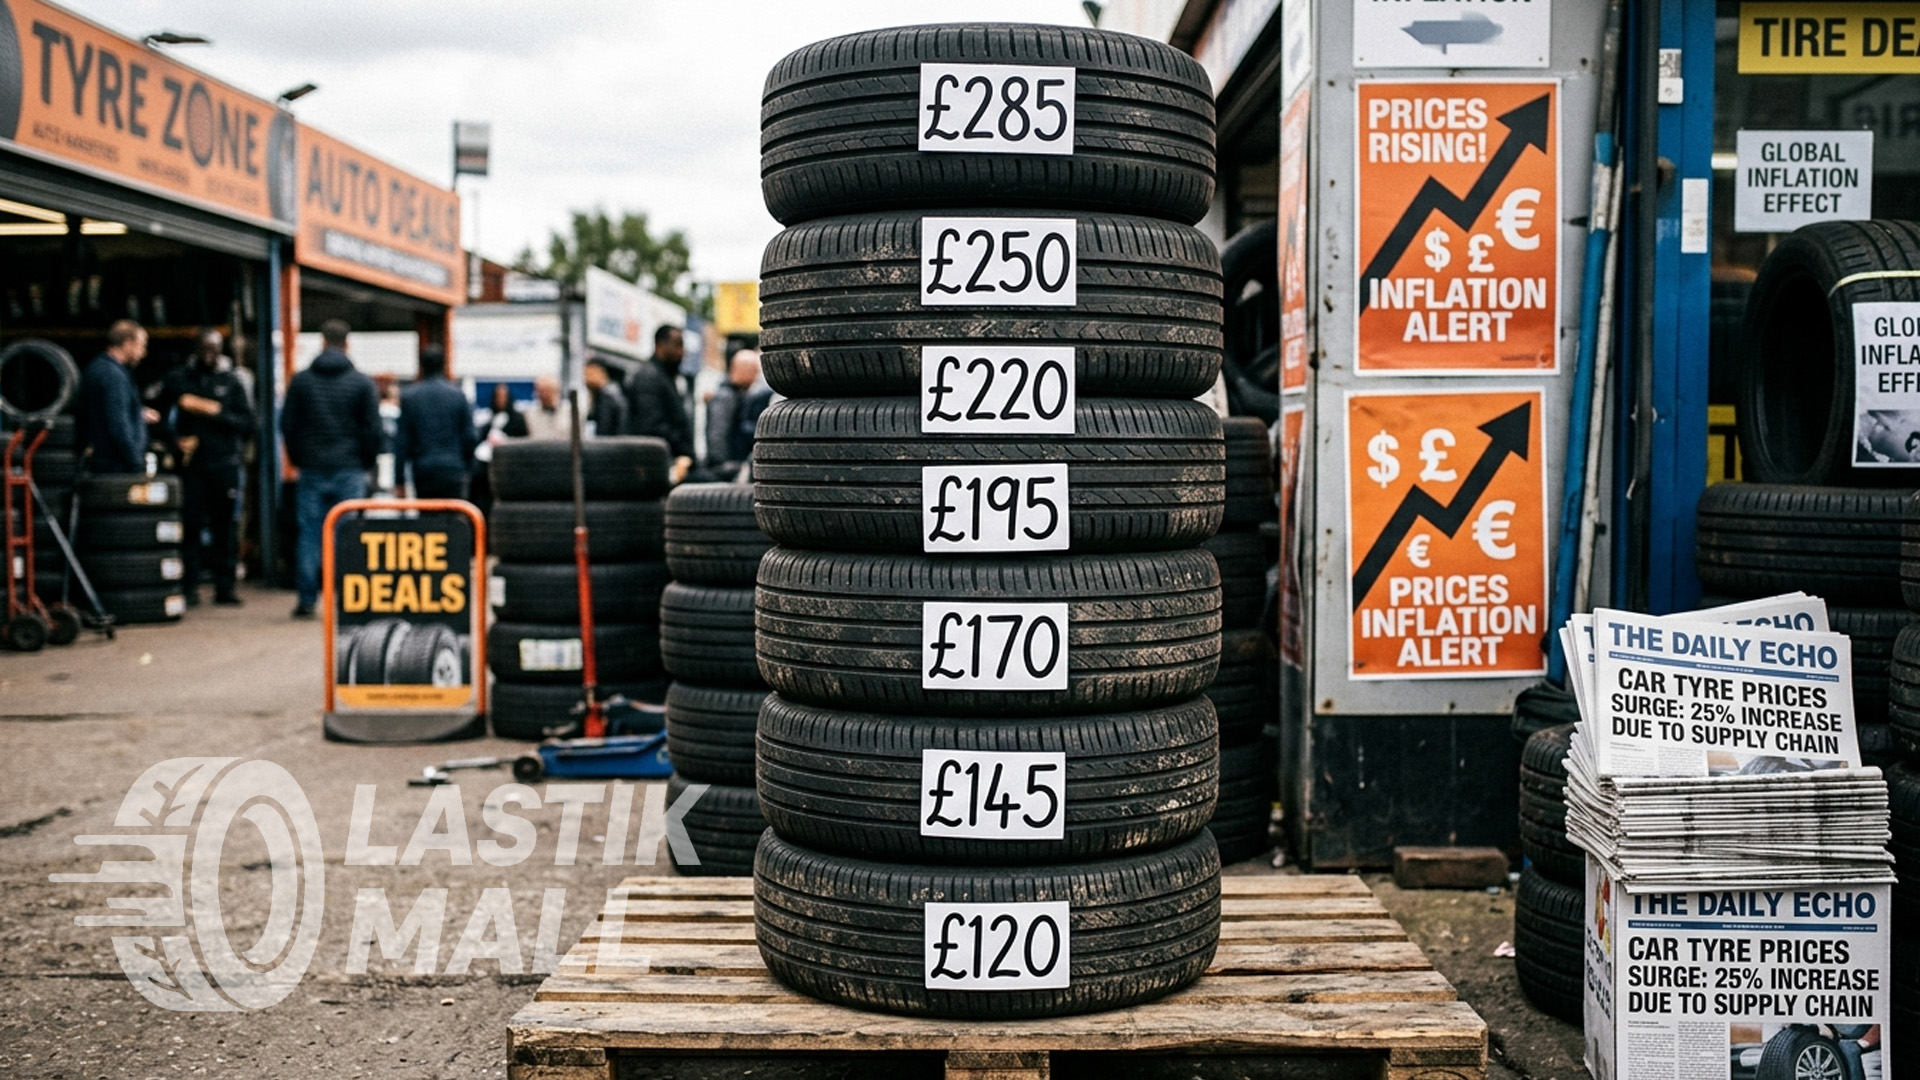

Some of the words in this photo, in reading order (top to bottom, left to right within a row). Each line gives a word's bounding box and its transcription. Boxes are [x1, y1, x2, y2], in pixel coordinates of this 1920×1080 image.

[1754, 17, 1846, 56] TIRE
[1863, 17, 1920, 56] DE
[32, 20, 148, 139] TYRE
[162, 78, 258, 177] ZONE
[924, 74, 1067, 141] £285
[1369, 98, 1488, 130] PRICES
[1369, 132, 1487, 163] RISING!
[1761, 142, 1846, 163] GLOBAL
[1748, 168, 1858, 188] INFLATION
[306, 145, 380, 228] AUTO
[389, 178, 456, 251] DEALS
[1764, 193, 1842, 213] EFFECT
[926, 228, 1070, 294] £250
[1369, 278, 1546, 309] INFLATION
[1403, 311, 1513, 342] ALERT
[1874, 316, 1920, 337] GLO
[927, 356, 1068, 421] £220
[929, 475, 1058, 542] £195
[361, 532, 448, 571] TIRE
[343, 573, 466, 613] DEALS
[1389, 574, 1509, 606] PRICES
[1361, 604, 1536, 638] INFLATION
[929, 612, 1061, 679] £170
[1397, 635, 1504, 667] ALERT
[1608, 622, 1663, 652] THE
[1672, 631, 1751, 661] DAILY
[1760, 640, 1838, 669] ECHO
[1618, 667, 1666, 694] CAR
[1673, 673, 1734, 700] TYRE
[1742, 681, 1827, 708] PRICES
[1611, 693, 1684, 719] SURGE:
[1690, 702, 1735, 724] 25%
[1742, 706, 1842, 732] INCREASE
[1612, 716, 1652, 739] DUE
[1658, 721, 1685, 742] TO
[1691, 725, 1767, 749] SUPPLY
[1775, 732, 1839, 754] CHAIN
[926, 759, 1058, 829] £145
[1698, 891, 1784, 917] DAILY
[1793, 891, 1876, 918] ECHO
[931, 913, 1060, 980] £120
[1628, 936, 1679, 961] CAR
[1687, 938, 1751, 962] TYRE
[1760, 939, 1850, 964] PRICES
[1628, 965, 1707, 988] SURGE:
[1715, 967, 1763, 989] 25%
[1771, 968, 1879, 991] INCREASE
[1629, 991, 1671, 1013] DUE
[1678, 992, 1706, 1014] TO
[1714, 993, 1798, 1016] SUPPLY
[1805, 994, 1873, 1018] CHAIN
